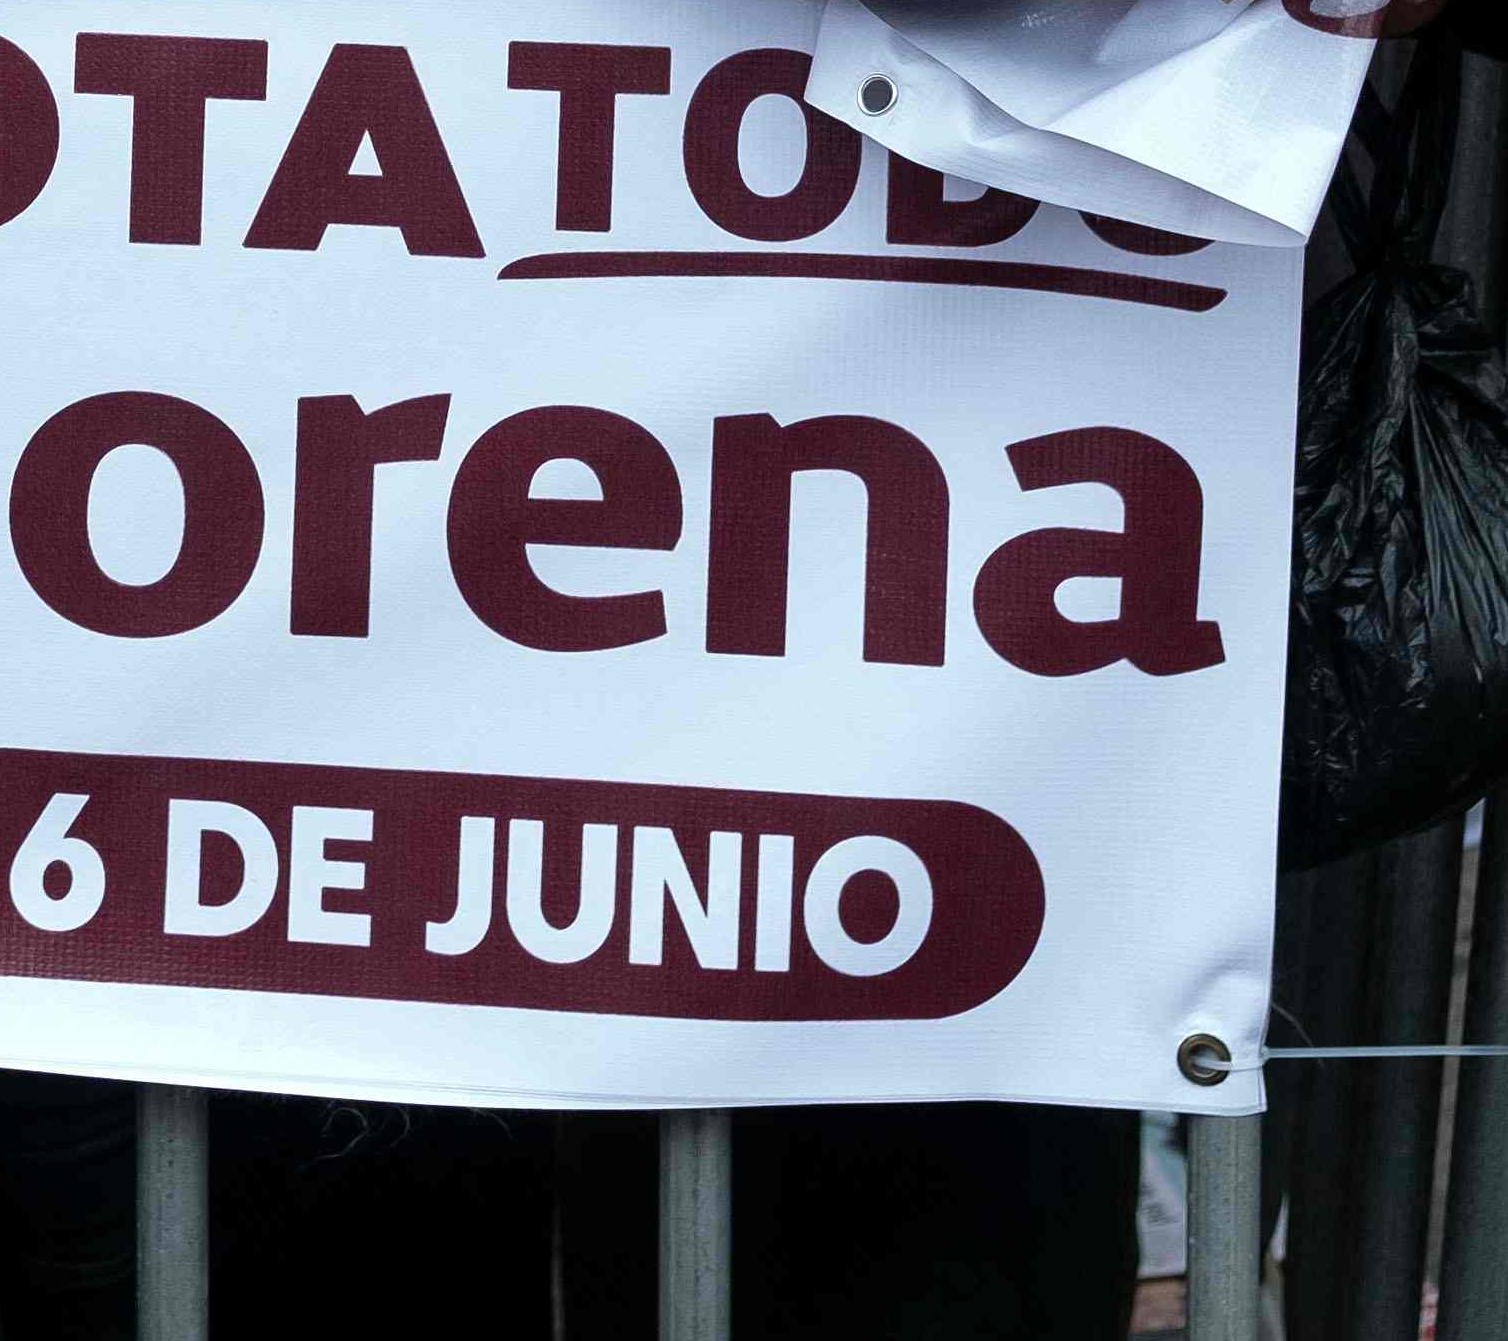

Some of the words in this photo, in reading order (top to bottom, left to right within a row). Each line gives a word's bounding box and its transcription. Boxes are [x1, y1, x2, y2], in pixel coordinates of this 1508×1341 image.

[507, 40, 1217, 257] TO
[9, 792, 107, 934] 6
[163, 799, 381, 950] DE
[424, 814, 935, 980] JUNIO
